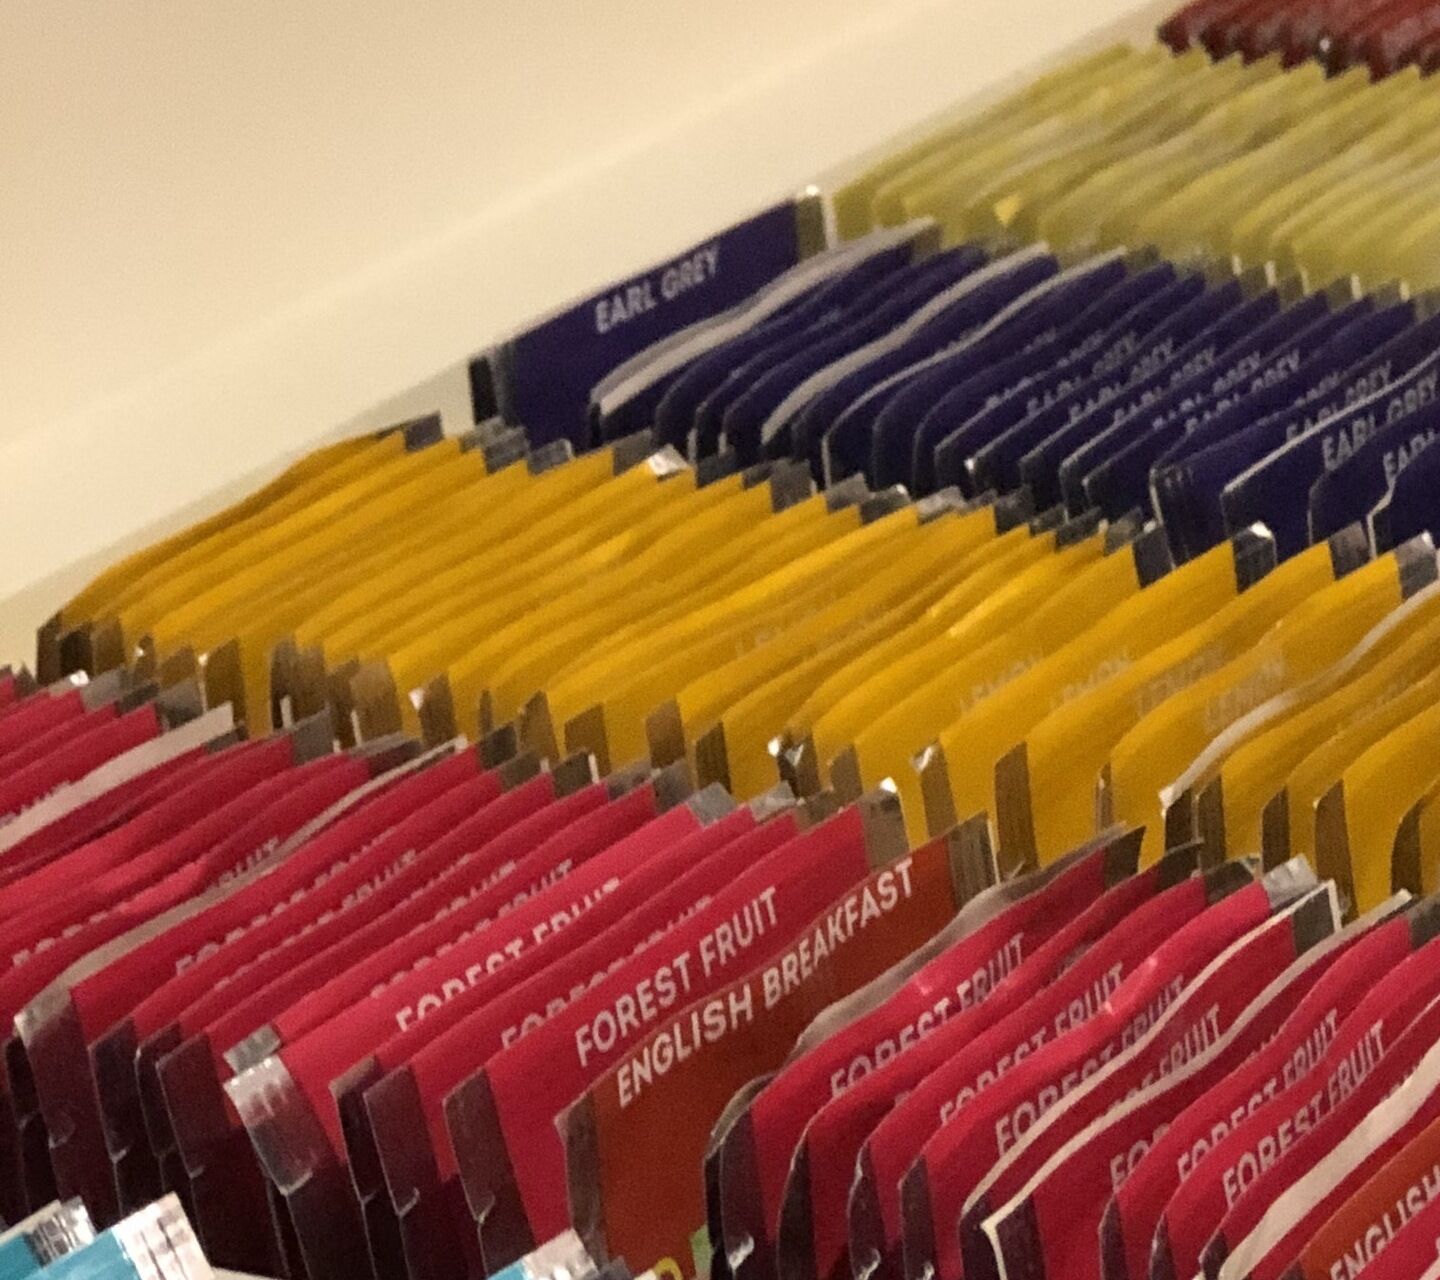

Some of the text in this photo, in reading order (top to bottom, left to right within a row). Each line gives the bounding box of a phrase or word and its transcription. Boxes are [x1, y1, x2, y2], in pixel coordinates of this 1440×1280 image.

[595, 243, 719, 334] EARL GREY
[574, 951, 692, 1068] FOREST
[699, 886, 777, 978] FRUIT
[617, 983, 753, 1109] ENGLISH
[762, 857, 914, 1011] BREAKFAST
[1222, 1091, 1323, 1209] FOREST
[1327, 1019, 1384, 1113] FRUIT
